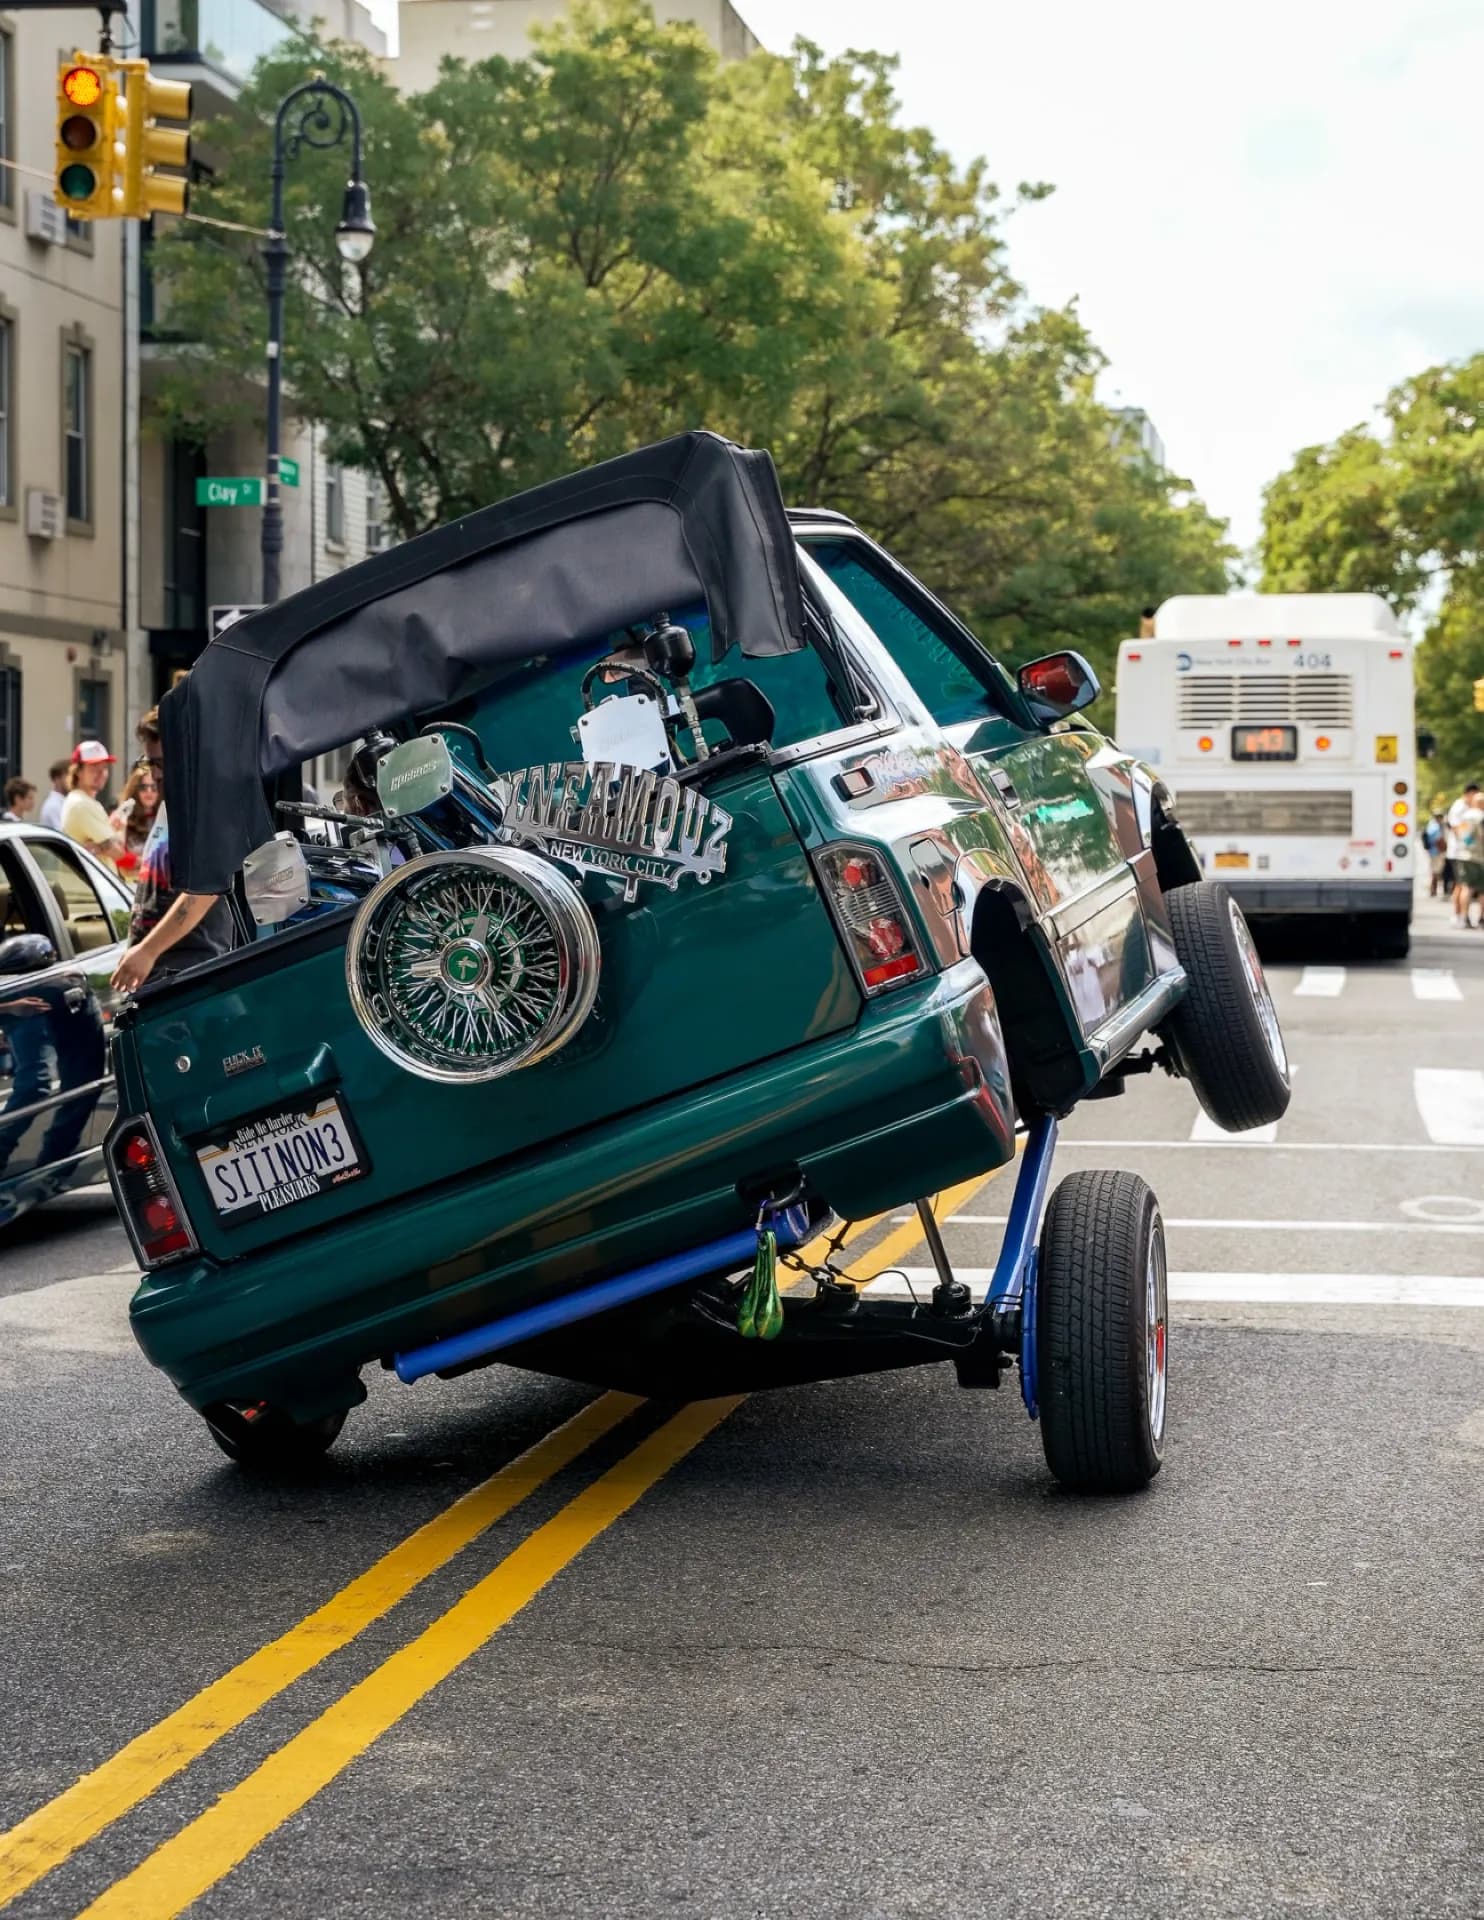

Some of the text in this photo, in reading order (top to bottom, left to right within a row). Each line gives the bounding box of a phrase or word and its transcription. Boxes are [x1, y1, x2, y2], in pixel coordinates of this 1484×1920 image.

[208, 482, 237, 506] Clay
[1294, 654, 1331, 668] 404
[551, 840, 671, 878] NEW YORK CITY
[236, 1113, 294, 1143] Ride Me Harder
[258, 1174, 321, 1212] PLEASURES
